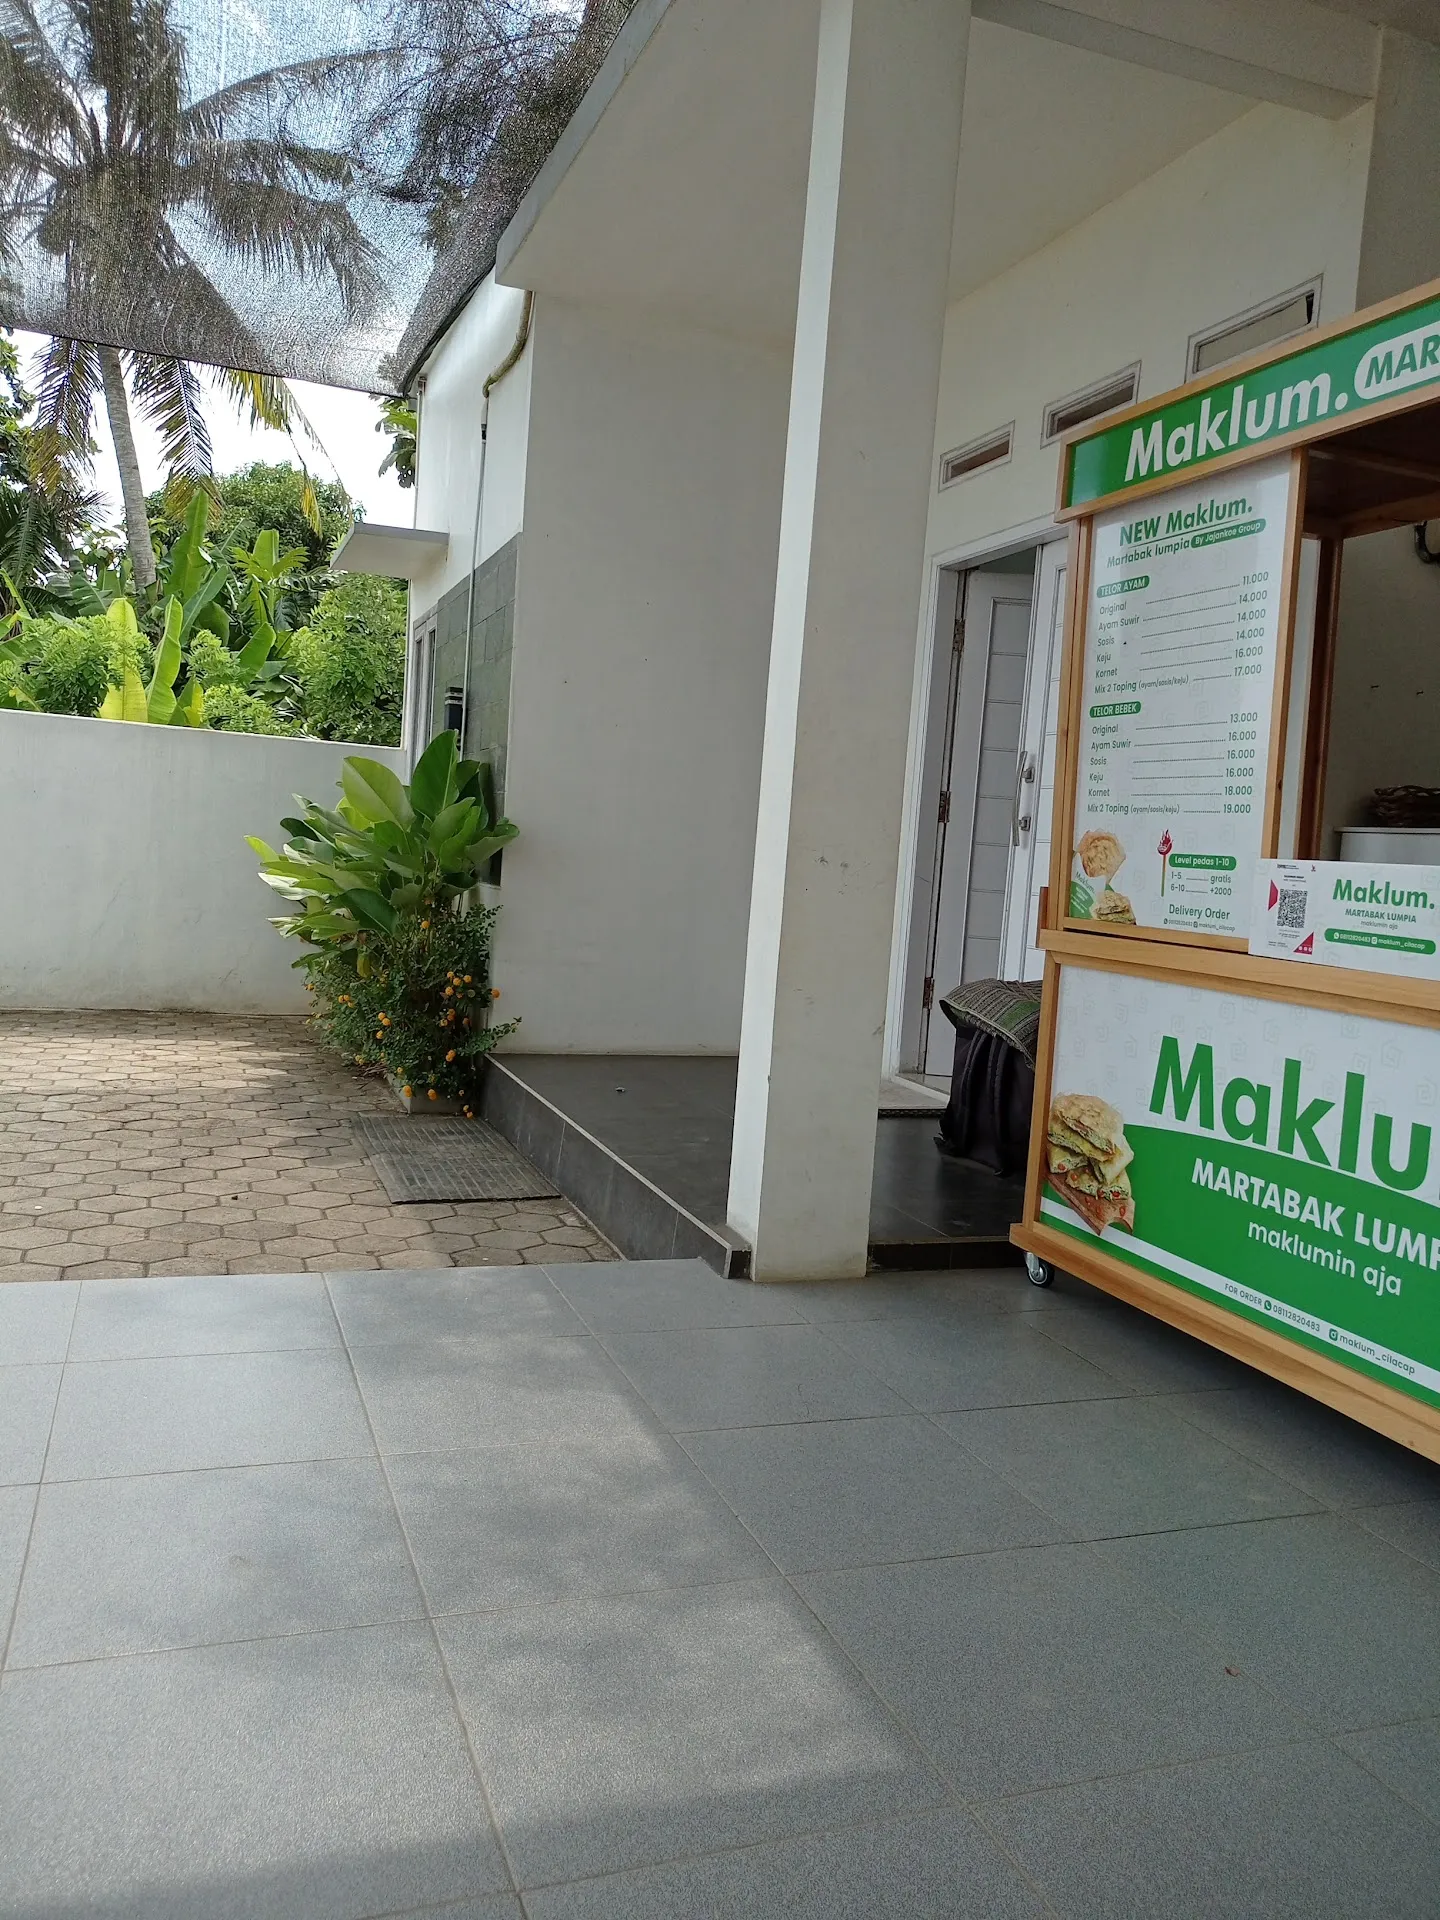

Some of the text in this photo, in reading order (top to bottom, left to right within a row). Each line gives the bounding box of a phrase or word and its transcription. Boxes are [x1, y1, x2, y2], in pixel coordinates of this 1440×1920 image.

[1124, 372, 1348, 481] Maklum.
[1120, 498, 1252, 546] NEW Maklum.
[1107, 522, 1261, 568] Martabak lumpia By Jajankoe Group
[1099, 572, 1269, 616] Original 11.000
[1100, 578, 1146, 595] TELOR AYAM
[1098, 590, 1268, 632] Ayam Suwir 14.000
[1097, 609, 1266, 647] Sosis 14.000
[1096, 627, 1265, 664] Keju 14.000
[1095, 646, 1263, 678] Kornet 16.000
[1094, 684, 1105, 694] Mix
[1107, 684, 1111, 692] 2
[1113, 681, 1137, 693] Toping
[1234, 664, 1262, 677] 17.000
[1093, 703, 1137, 717] TELOR BEBEK
[1092, 712, 1258, 736] Original 13.000
[1091, 731, 1257, 752] Ayam Suwir 16.000
[1090, 749, 1255, 766] Sosis 16.000
[1089, 767, 1254, 783] Keju 16.000
[1088, 785, 1253, 797] Kornet 18.000
[1087, 804, 1099, 813] Mix
[1105, 804, 1129, 815] Toping
[1223, 804, 1251, 814] 19.000
[1174, 856, 1230, 866] Level pedas 1-10
[1170, 883, 1232, 895] 6-10 +2000
[1171, 871, 1232, 884] 1-5 gratis
[1332, 878, 1435, 910] Maklum.
[1169, 904, 1230, 920] Delivery Order
[1345, 908, 1417, 923] MARTABAK LUMPIA
[1361, 920, 1388, 928] maklumin
[1149, 1035, 1440, 1192] Maklu
[1191, 1157, 1346, 1238] MARTABAK
[1248, 1222, 1402, 1296] maklumin aja
[1224, 1283, 1415, 1375] FOR ORDER 08112820483 maklum_cilacap
